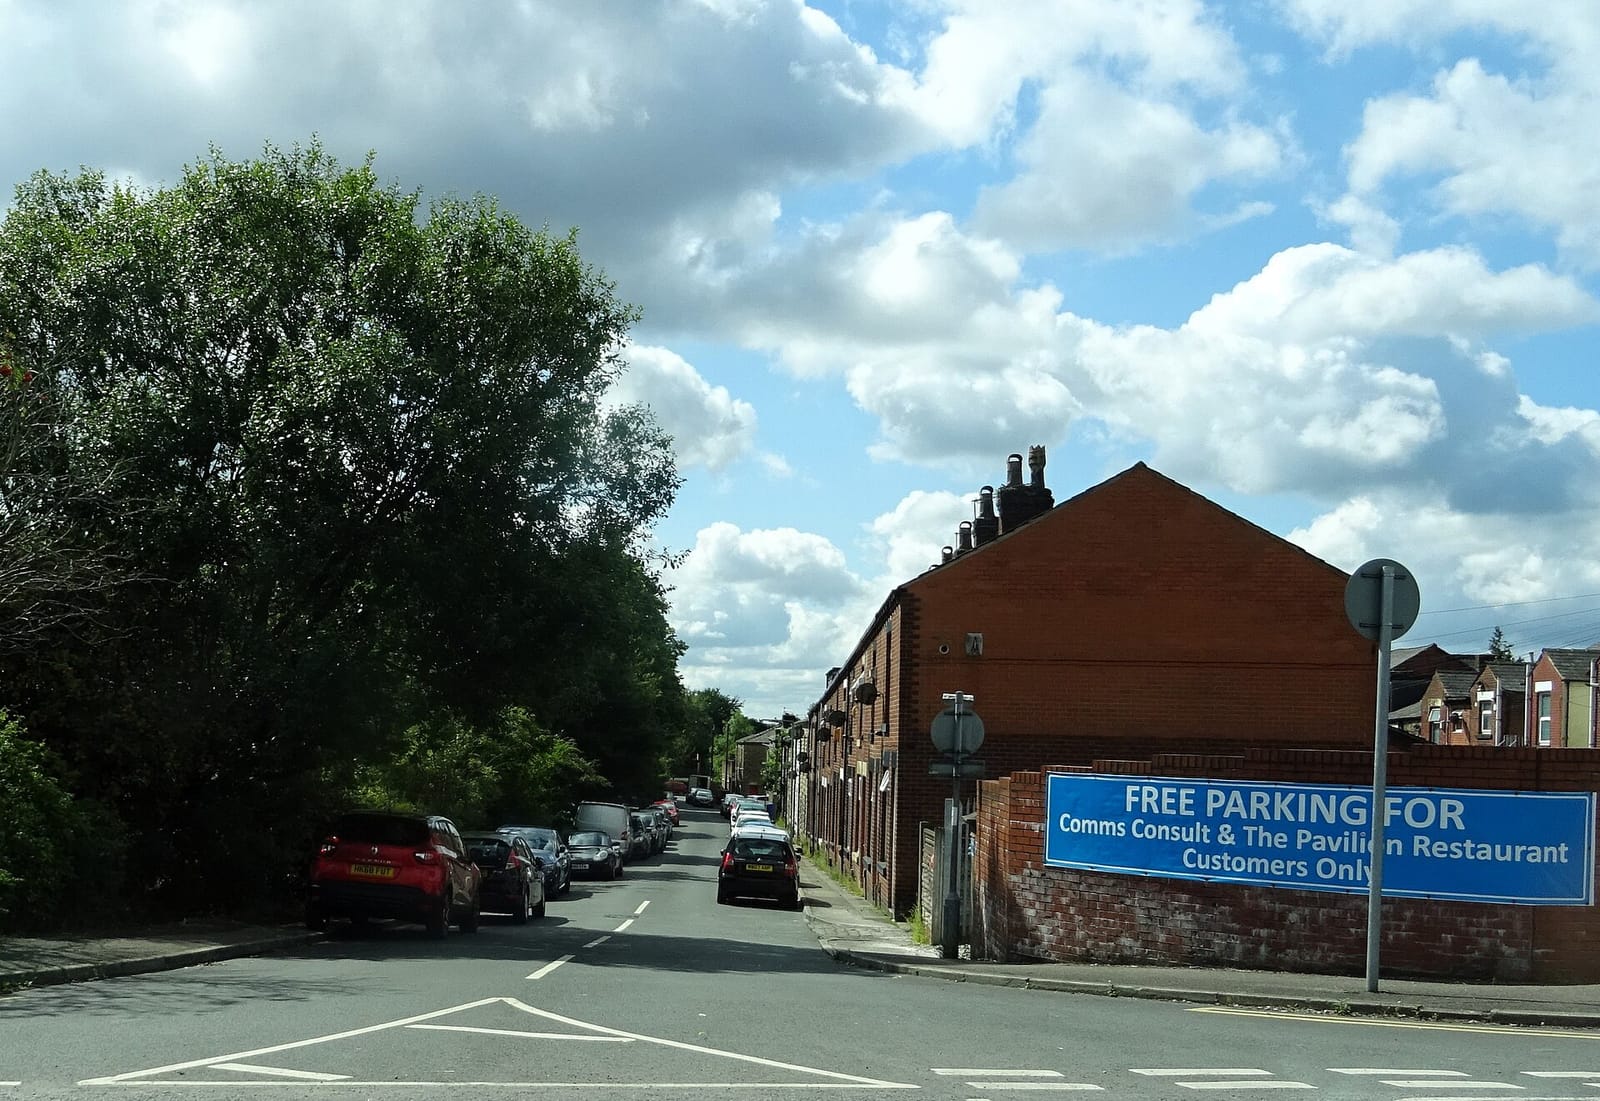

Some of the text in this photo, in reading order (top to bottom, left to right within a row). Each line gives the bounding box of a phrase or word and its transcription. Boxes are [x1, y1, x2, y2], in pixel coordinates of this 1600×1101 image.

[1126, 786, 1465, 830] FREE PARKING FOR
[1059, 813, 1126, 837] Comms
[1131, 818, 1210, 843] Consult
[1217, 824, 1236, 845] &
[1243, 826, 1287, 849] The
[1413, 835, 1568, 863] Restaurant
[1183, 848, 1308, 877] Customers
